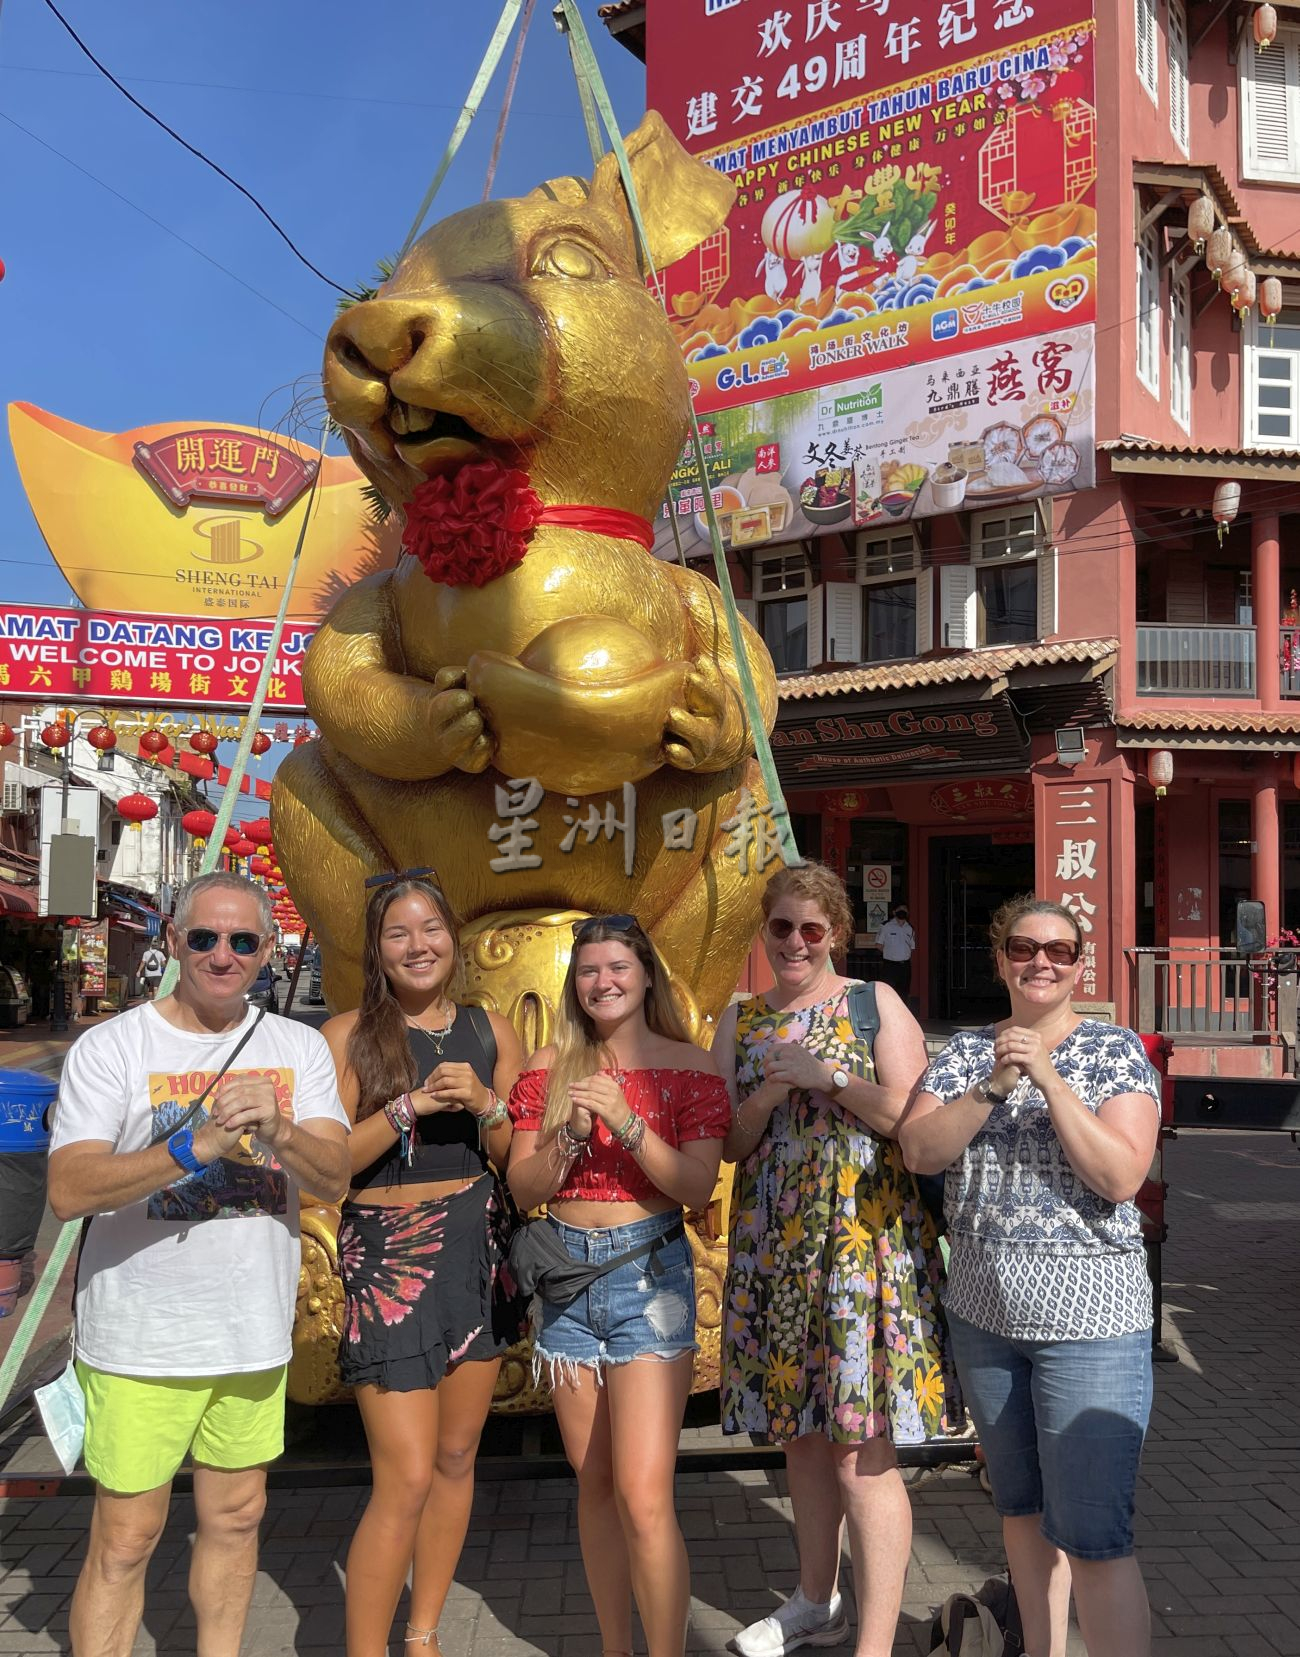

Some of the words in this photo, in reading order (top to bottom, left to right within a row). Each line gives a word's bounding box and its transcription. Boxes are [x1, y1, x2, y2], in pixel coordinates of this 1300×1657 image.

[706, 147, 748, 173] MAT
[752, 107, 863, 163] MENYAMBUT
[869, 84, 932, 123] TAHUN
[937, 64, 993, 102] BARU
[999, 45, 1050, 80] CINA
[787, 131, 871, 172] CHINESE
[878, 112, 923, 143] NEW
[930, 92, 987, 125] YEAR
[944, 202, 957, 246] 癸卯年
[935, 319, 956, 332] AGM
[810, 345, 863, 369] JONKER
[866, 334, 907, 354] WALK
[717, 363, 760, 390] G.L.
[821, 406, 833, 416] Dr
[836, 396, 878, 413] Nutrition
[889, 437, 908, 446] Ginger
[174, 436, 282, 480] 開運門
[712, 458, 732, 472] ALI
[175, 568, 241, 587] SHENG
[248, 574, 279, 590] TAI
[192, 586, 263, 598] INTERNATIONAL
[0, 615, 80, 641] MAT
[88, 619, 222, 649] DATANG
[231, 629, 273, 652] KE
[9, 643, 168, 669] WELCOME
[175, 653, 216, 671] TO
[814, 715, 890, 743] Shu
[888, 710, 998, 737] Gong
[816, 754, 841, 763] House
[843, 756, 851, 764] of
[853, 754, 890, 764] Authentic
[1055, 786, 1097, 933] 三叔公
[1082, 941, 1097, 996] 有限公司
